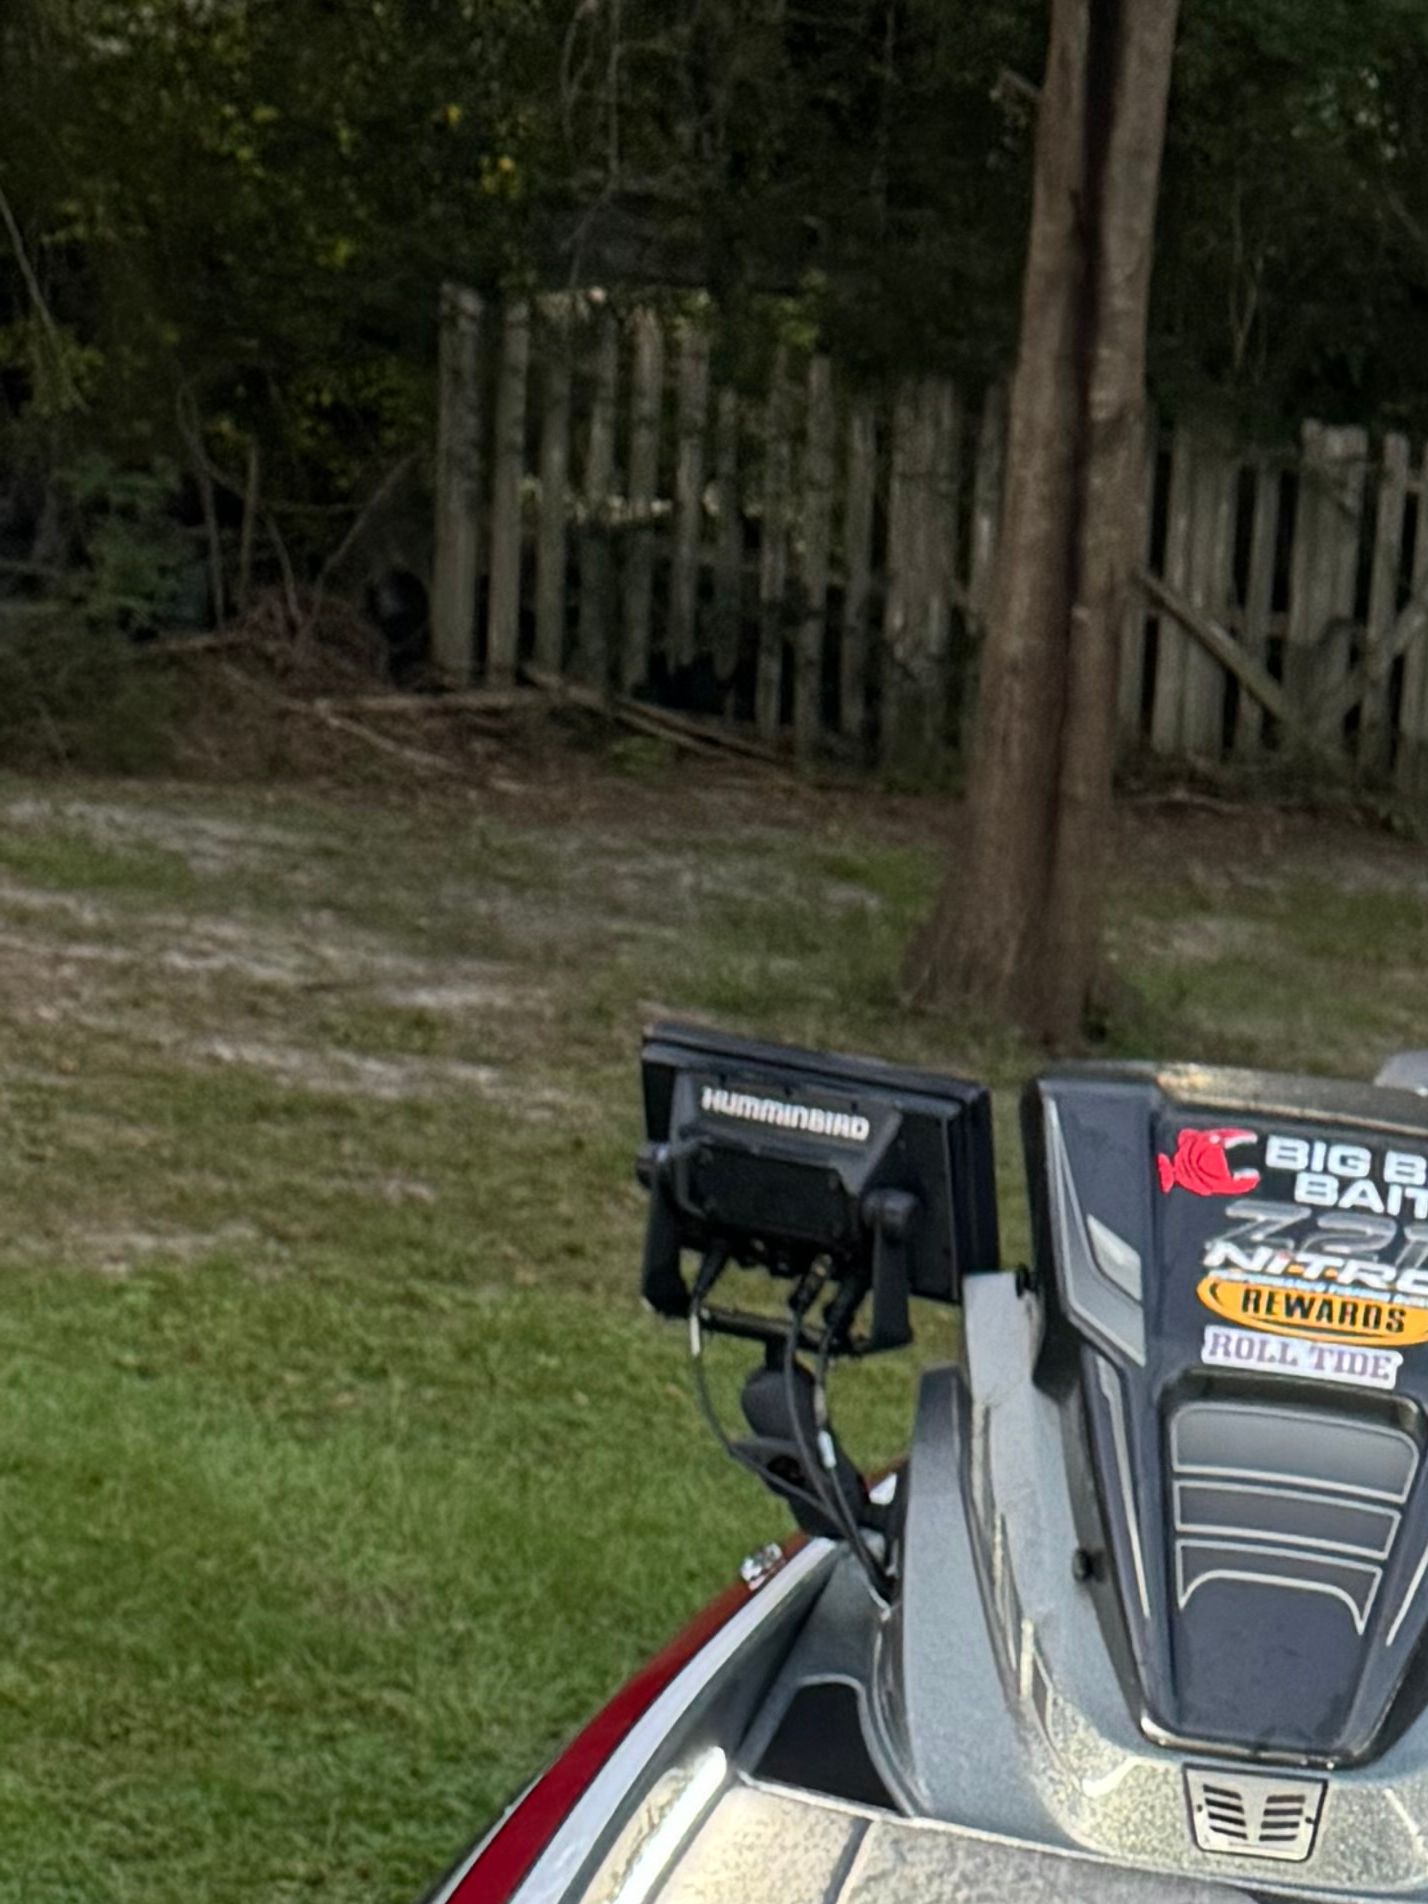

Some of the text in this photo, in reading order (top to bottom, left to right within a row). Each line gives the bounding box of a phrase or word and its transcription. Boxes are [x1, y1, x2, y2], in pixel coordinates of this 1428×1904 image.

[701, 1086, 870, 1141] HUMMINBIRD
[1265, 1134, 1372, 1178] BIG
[1241, 1286, 1407, 1334] REWARDS
[1208, 1332, 1391, 1381] ROLL TIDE
